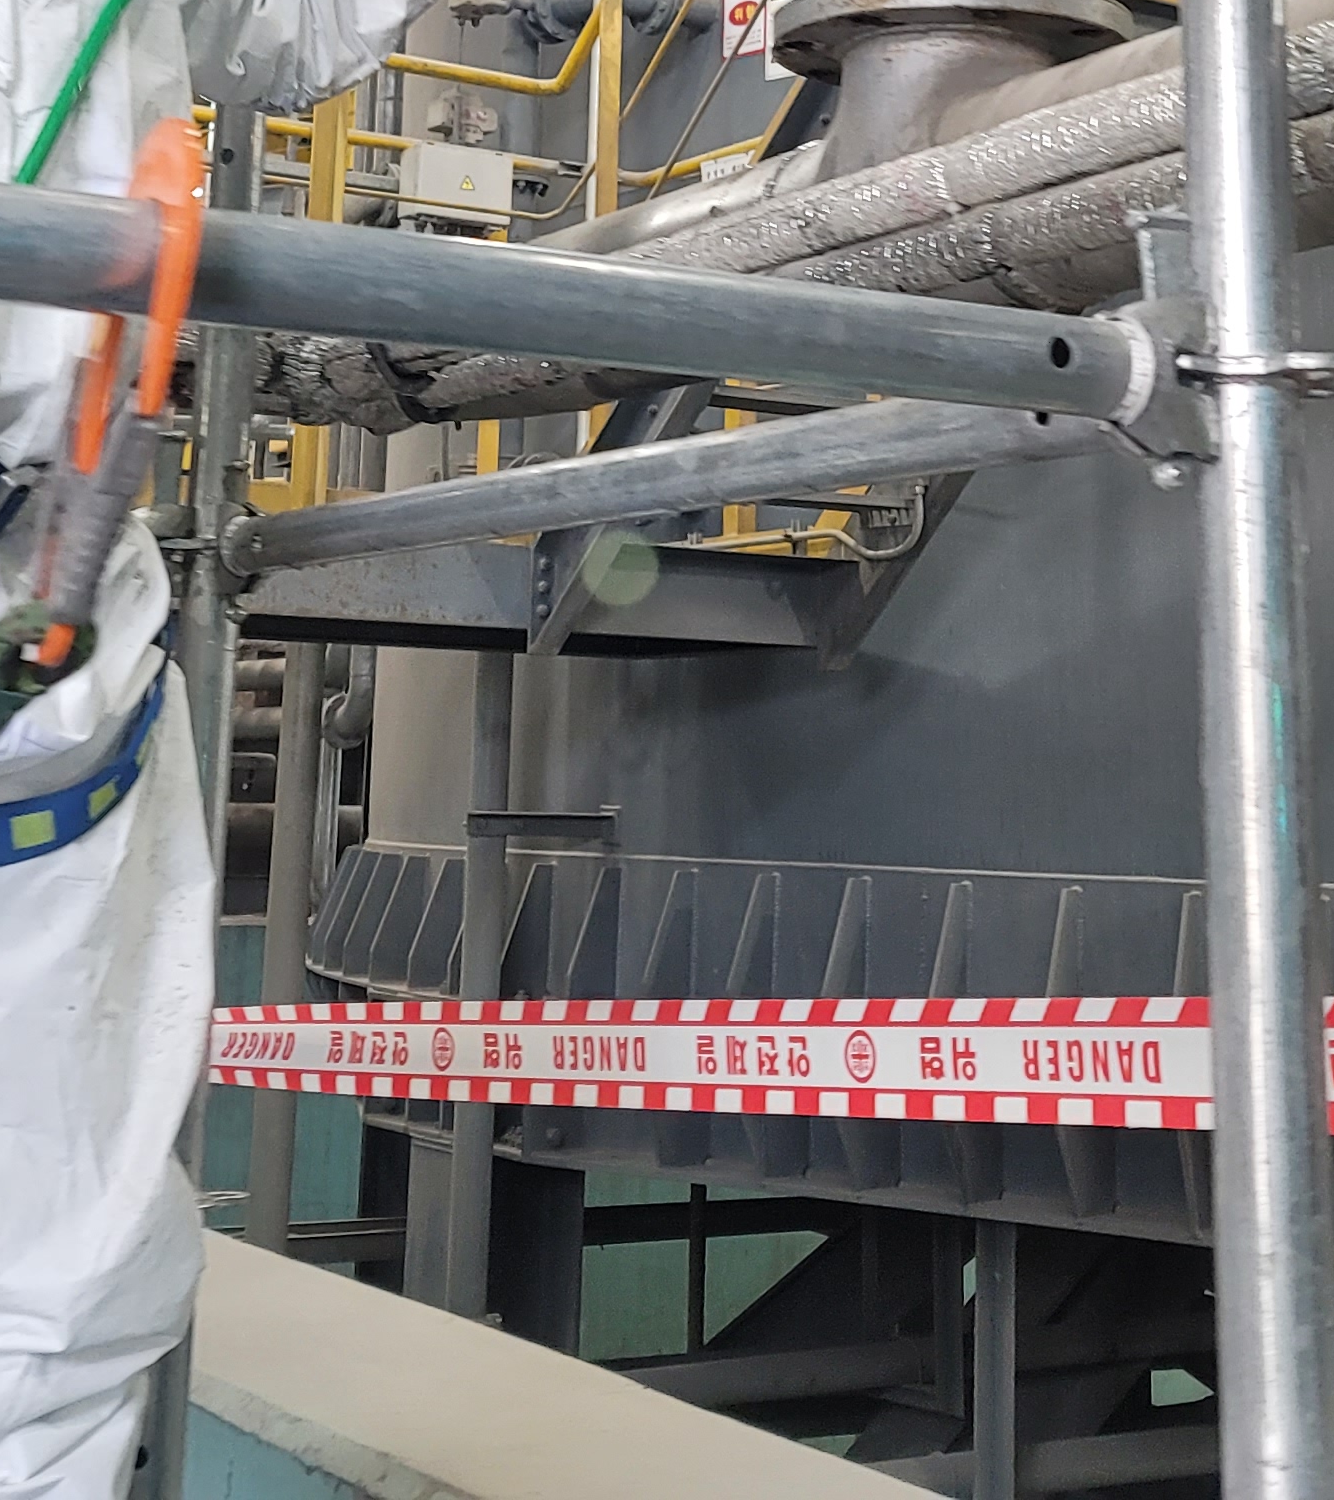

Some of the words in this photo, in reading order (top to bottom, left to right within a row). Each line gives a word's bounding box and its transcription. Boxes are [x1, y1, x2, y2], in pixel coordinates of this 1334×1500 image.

[220, 1031, 296, 1061] DANGER
[327, 1029, 410, 1067] 안전제일
[482, 1031, 523, 1071] 위험
[552, 1035, 647, 1073] DANGER
[695, 1034, 812, 1078] 안전제일
[918, 1035, 978, 1082] 위험
[1021, 1038, 1163, 1085] DANGER
